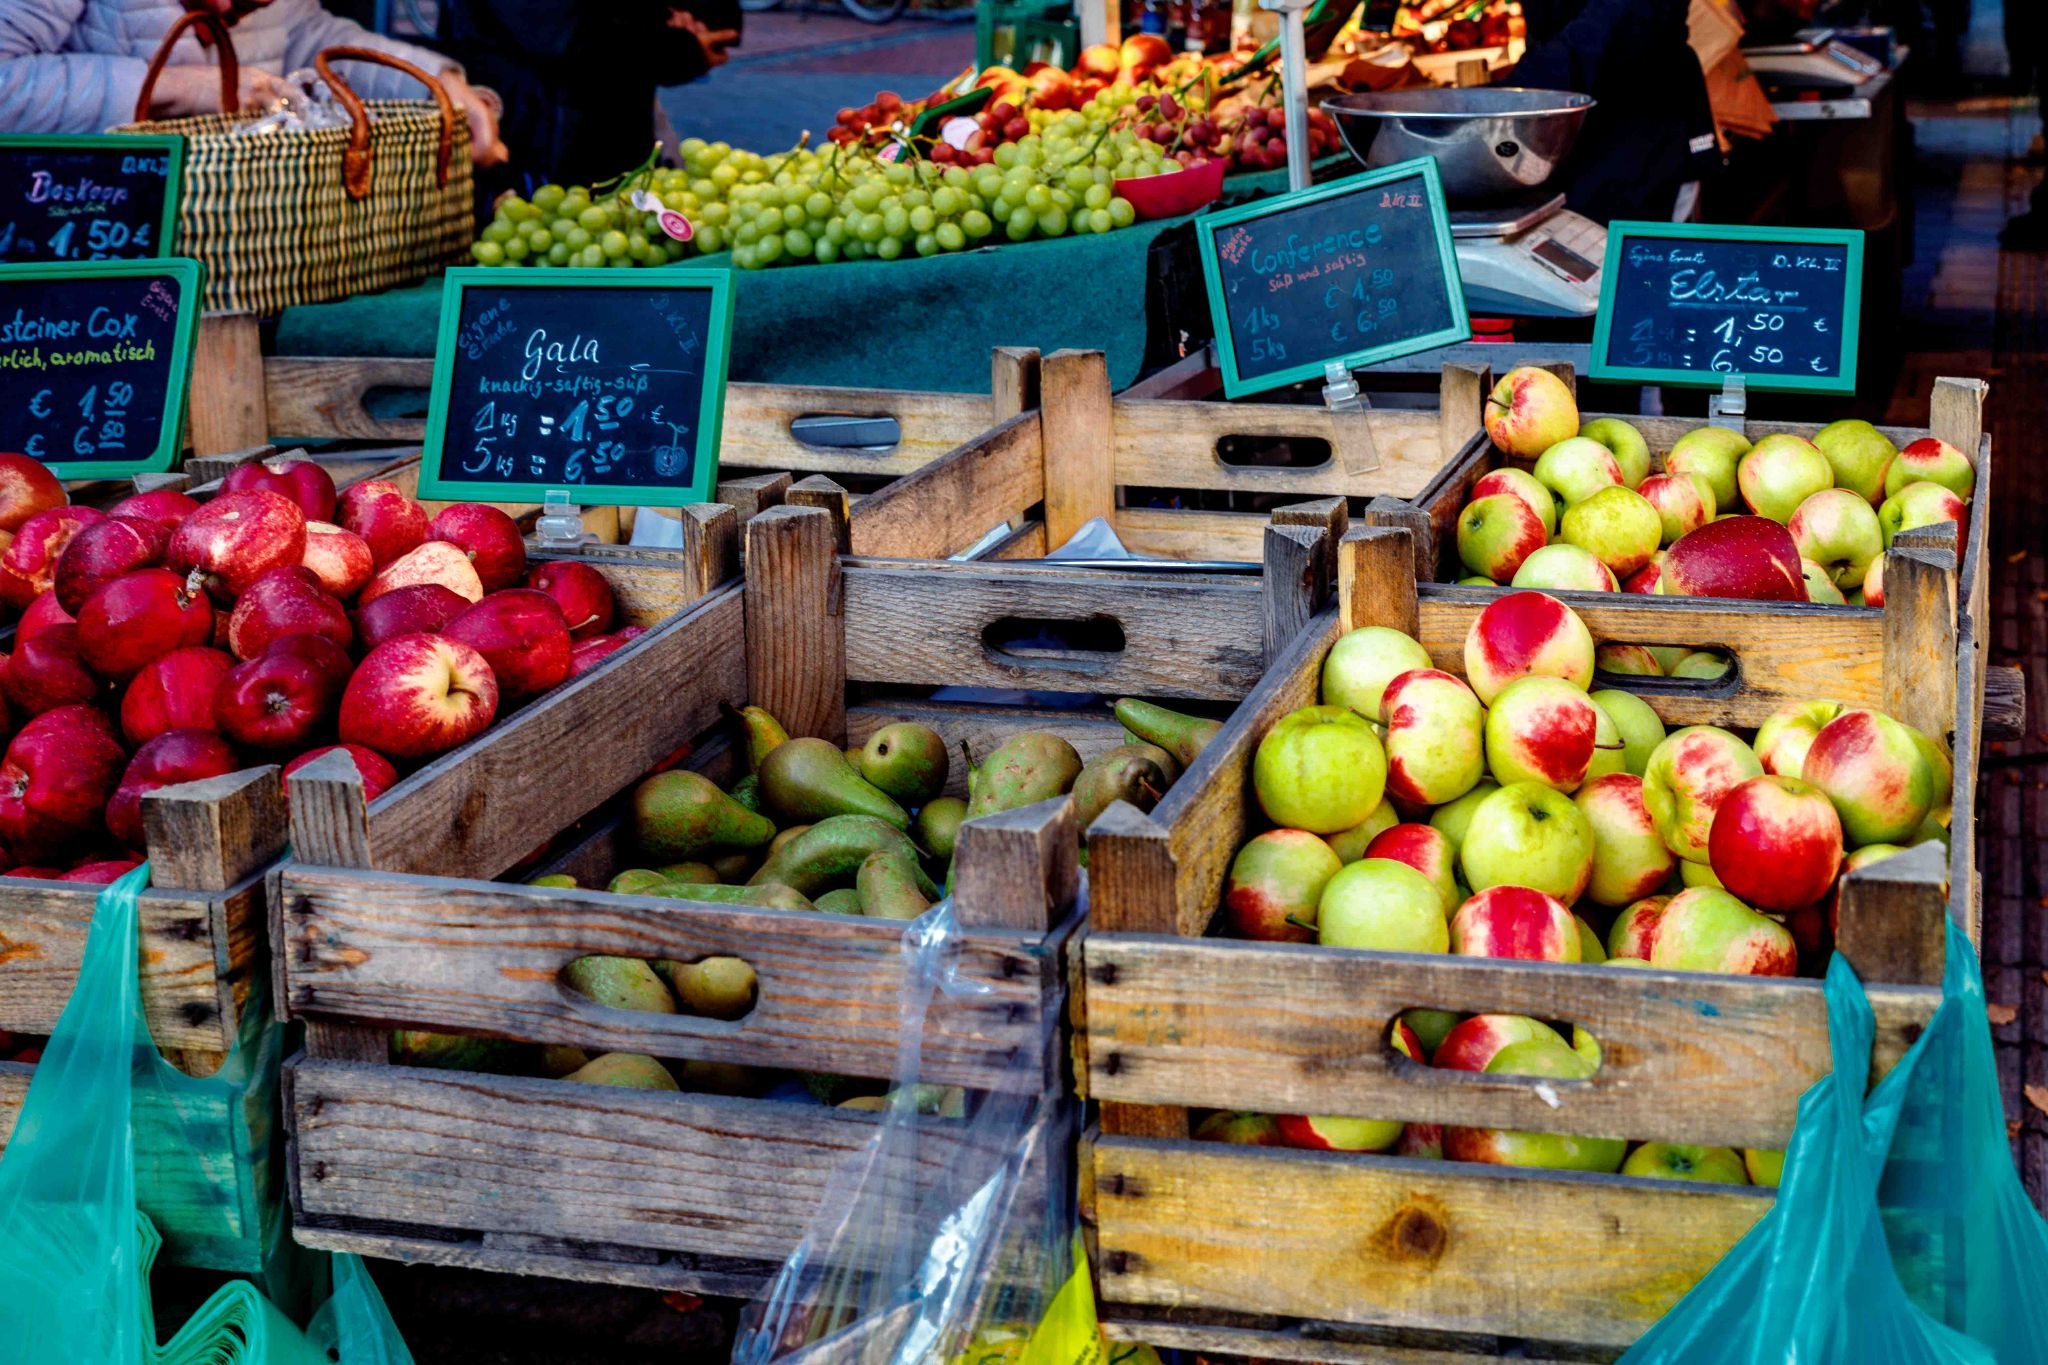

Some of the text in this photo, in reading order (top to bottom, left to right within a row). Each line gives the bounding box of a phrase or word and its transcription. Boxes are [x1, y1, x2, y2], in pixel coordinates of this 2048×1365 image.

[1251, 223, 1383, 275] Conference
[1296, 268, 1320, 282] und
[1325, 253, 1367, 272] saftig
[87, 306, 138, 339] Cox
[50, 339, 155, 366] aromatisch
[522, 328, 600, 381] Gala
[29, 389, 53, 419] €
[24, 434, 46, 457] €
